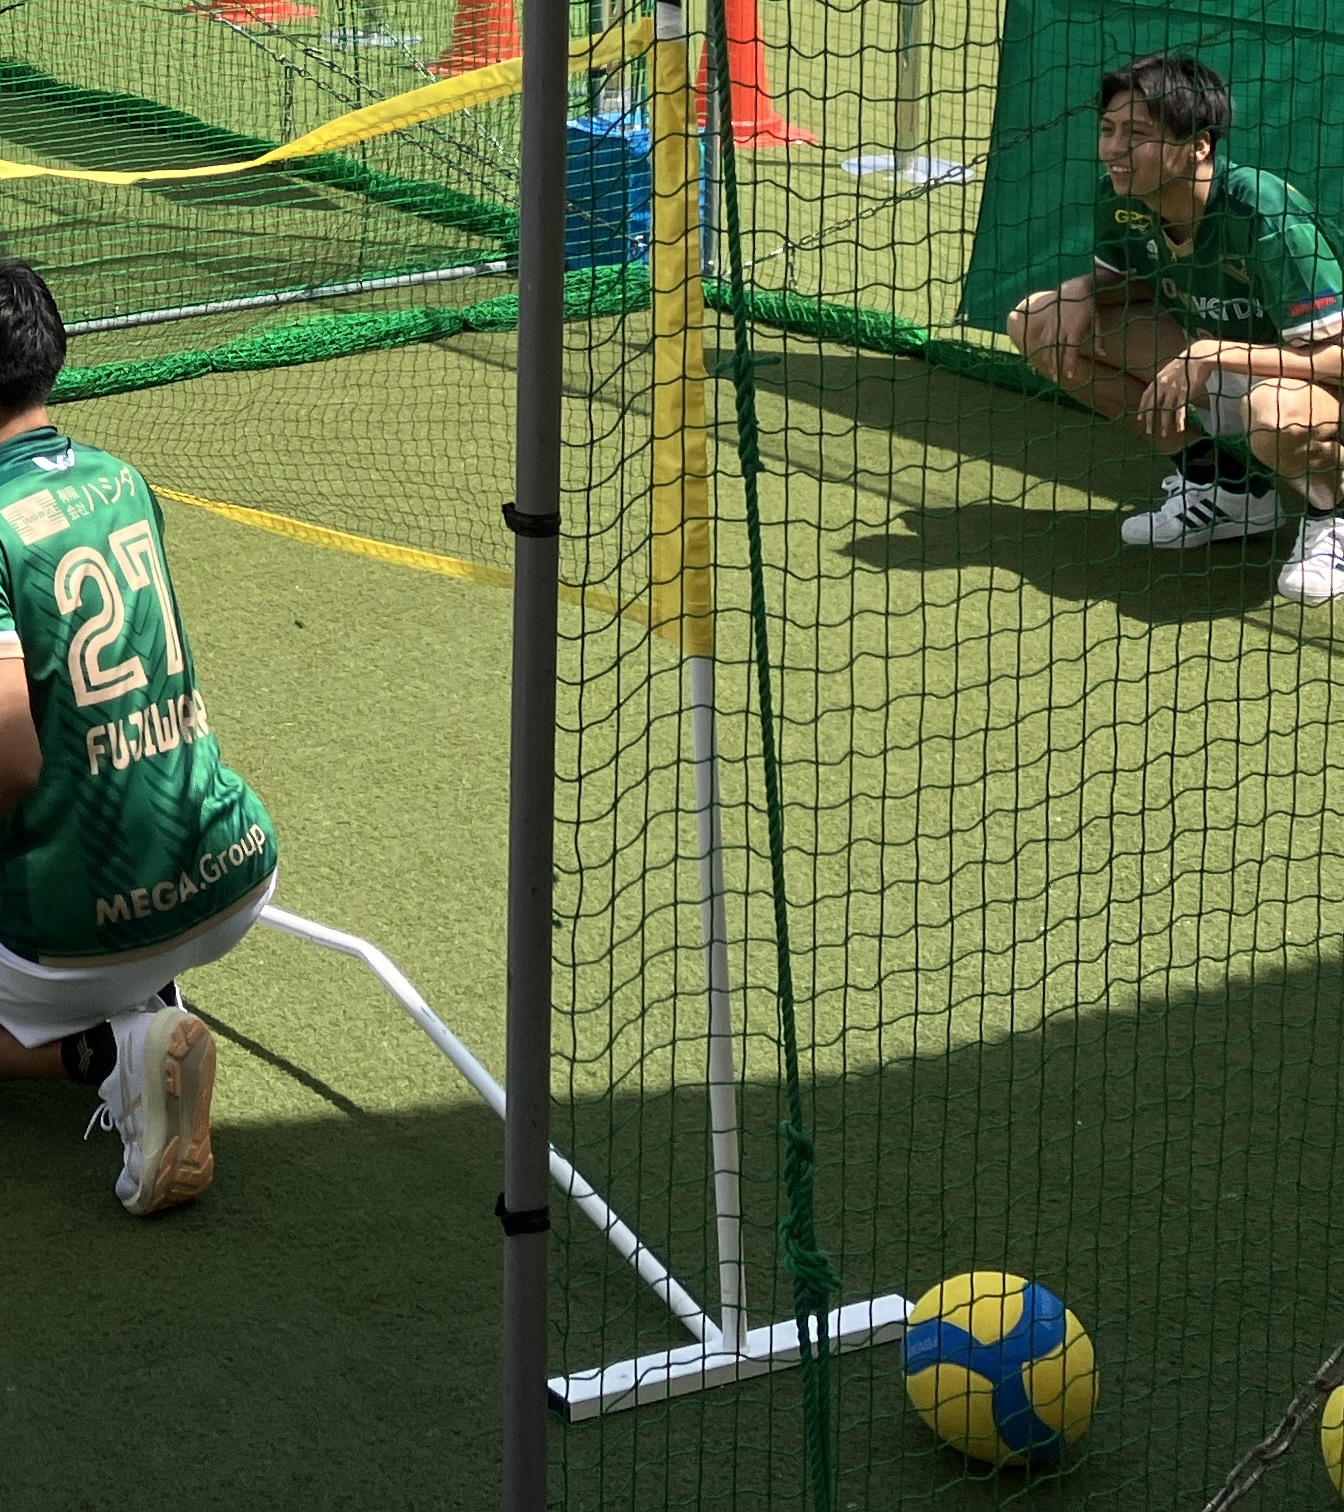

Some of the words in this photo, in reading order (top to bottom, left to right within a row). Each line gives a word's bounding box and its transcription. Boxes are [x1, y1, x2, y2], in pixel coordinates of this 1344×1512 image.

[81, 465, 136, 512] ハシダ
[54, 519, 184, 708] 27
